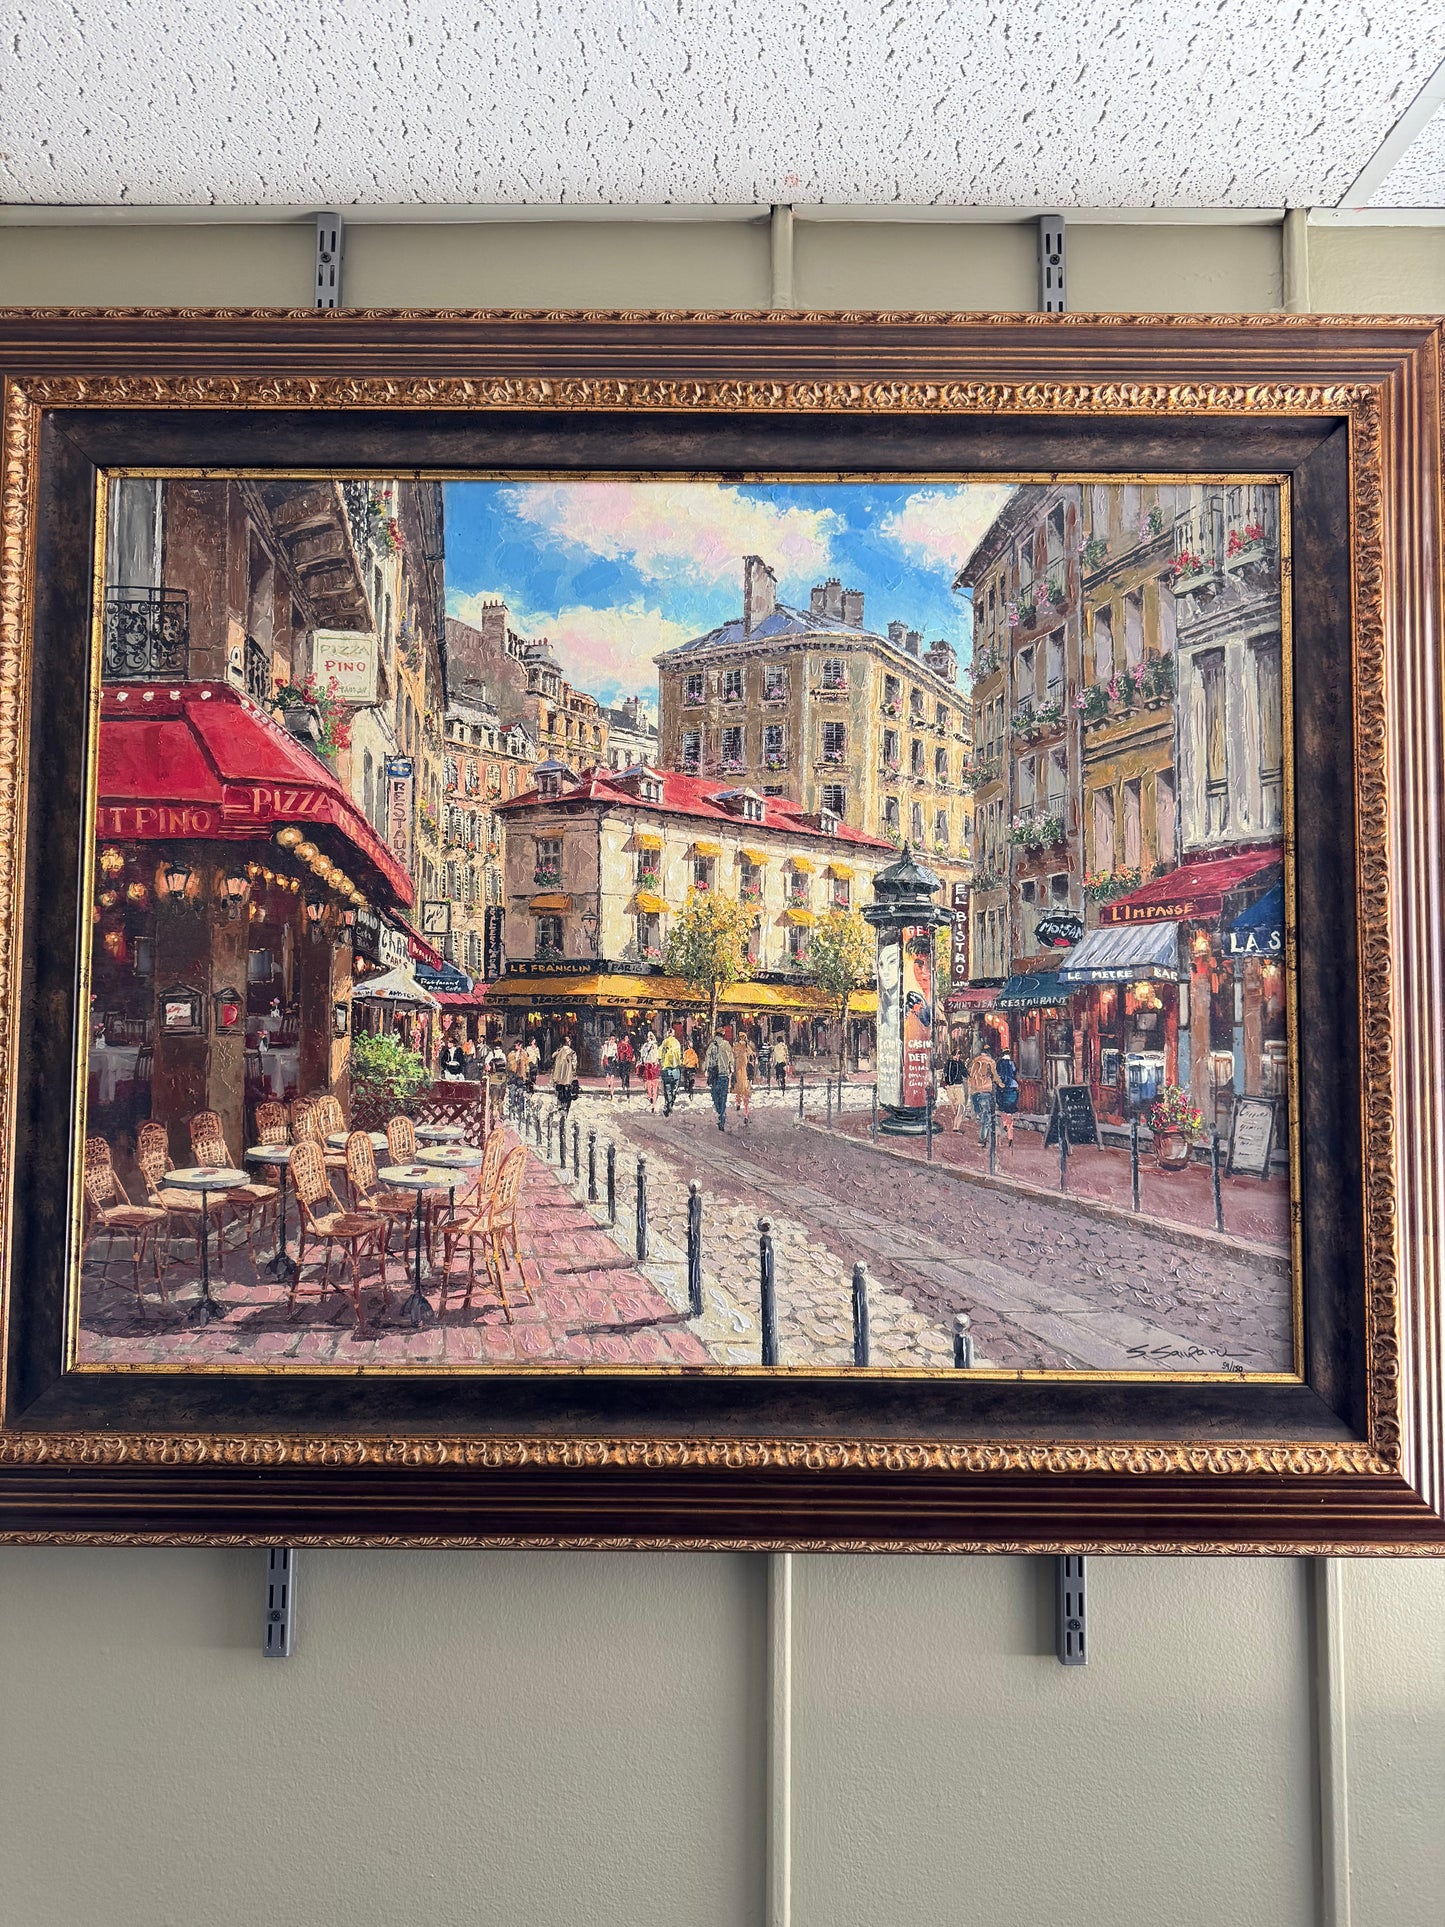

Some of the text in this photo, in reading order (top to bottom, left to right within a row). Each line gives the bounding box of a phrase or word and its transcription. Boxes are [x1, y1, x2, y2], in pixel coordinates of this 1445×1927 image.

[324, 660, 366, 672] PINO
[252, 787, 333, 818] PIZZA
[136, 806, 212, 834] PINO
[392, 781, 408, 864] RESTAUR
[955, 911, 967, 975] BISTRO
[1229, 930, 1281, 953] LA S
[510, 964, 591, 974] LE FRANKLIN
[1067, 971, 1083, 980] LE
[1153, 966, 1178, 981] BAR
[1000, 996, 1068, 1007] RESTAURANT
